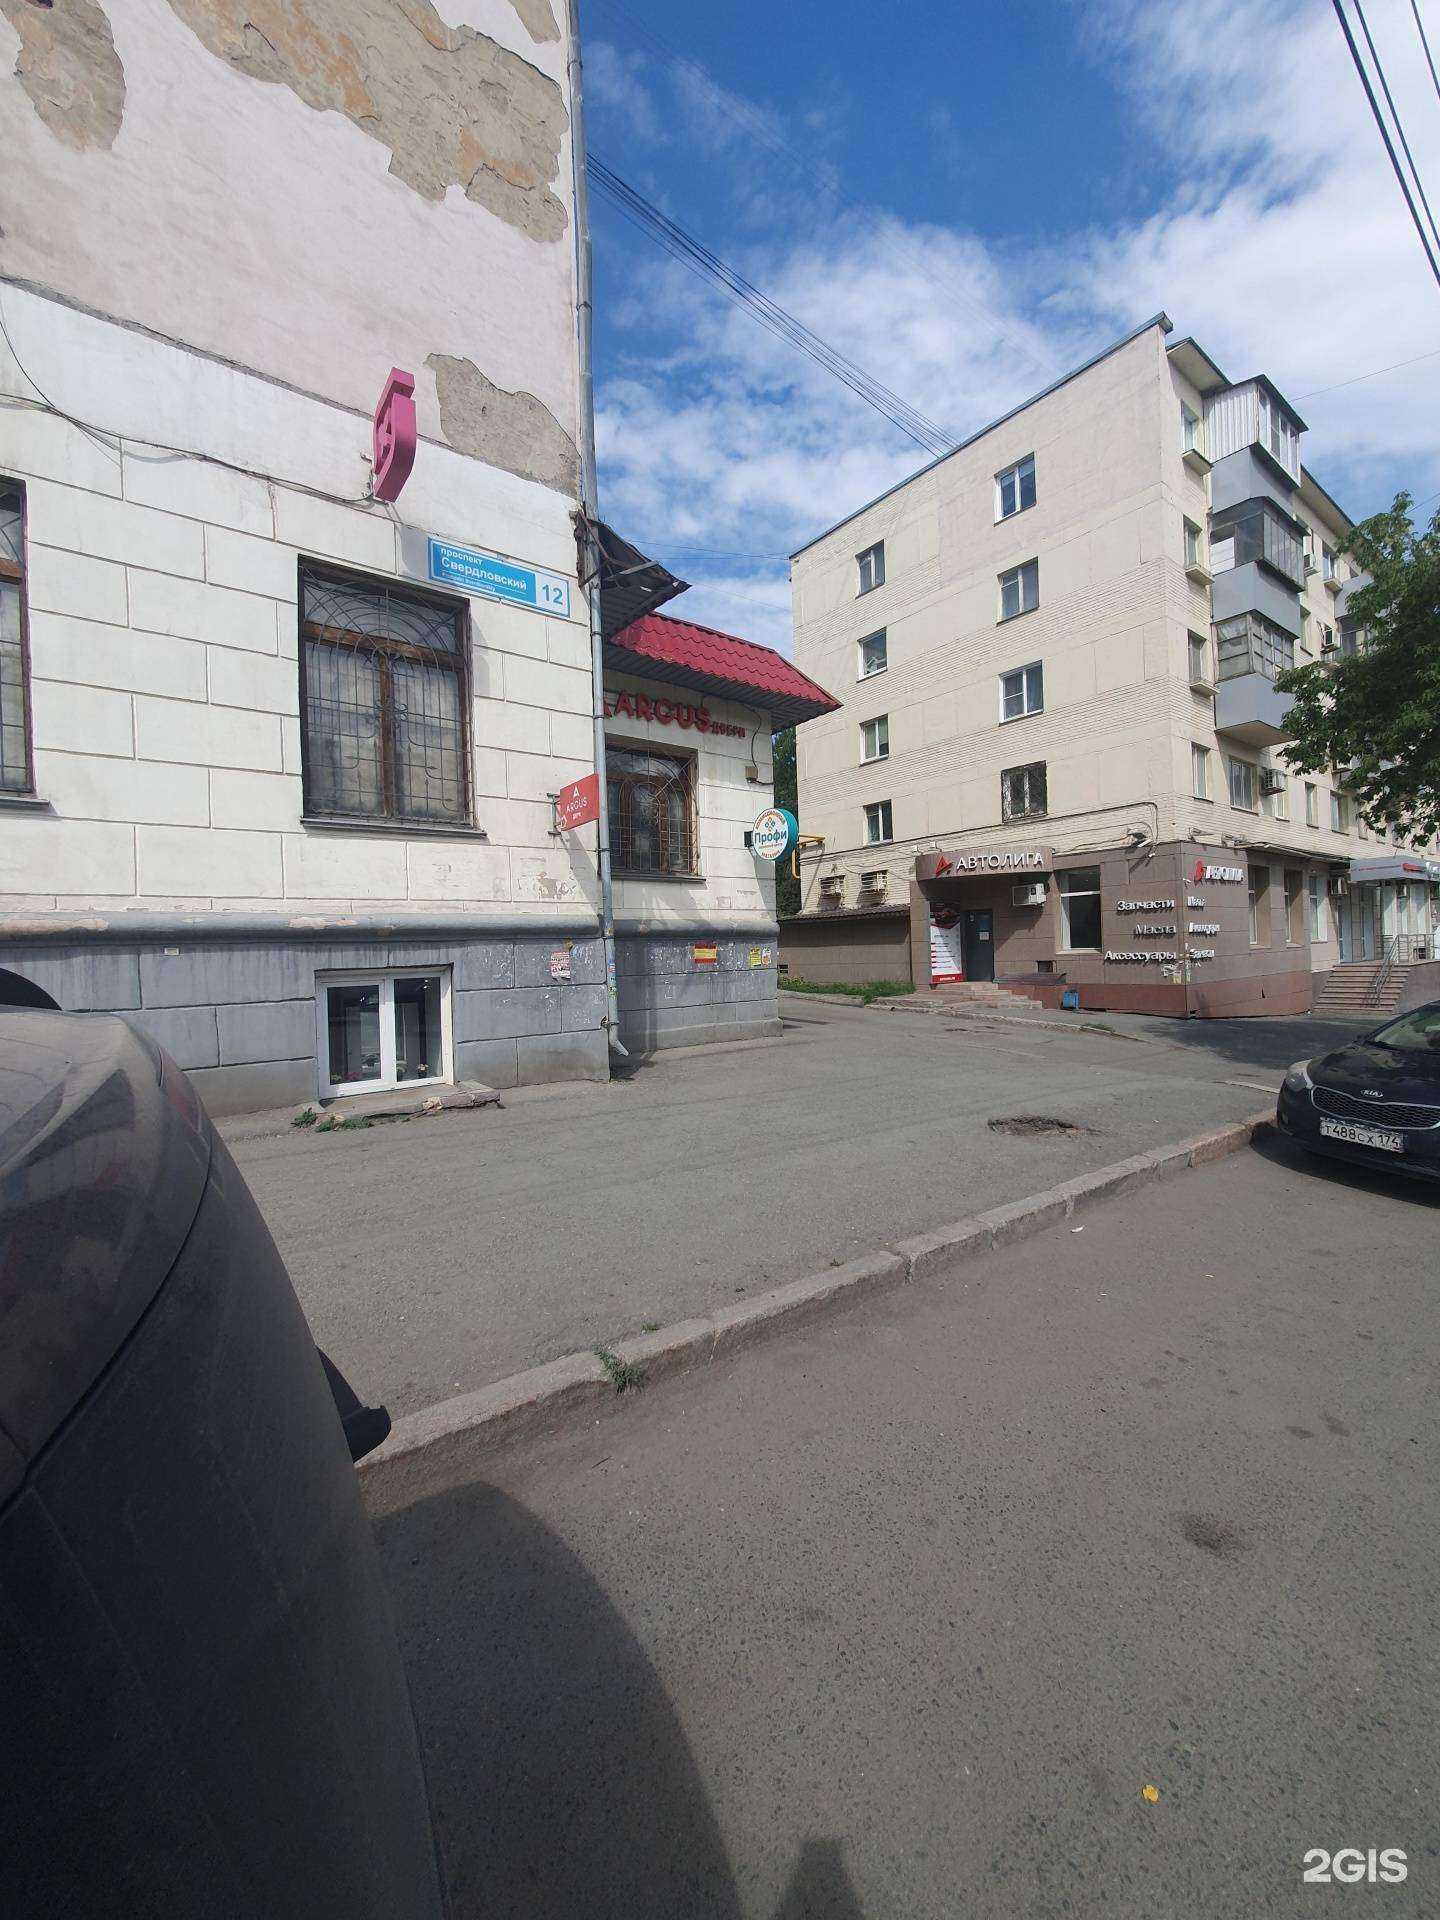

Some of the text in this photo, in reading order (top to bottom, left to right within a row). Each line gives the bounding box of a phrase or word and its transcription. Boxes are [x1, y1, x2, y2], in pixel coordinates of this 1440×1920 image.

[440, 547, 483, 566] проспект
[441, 557, 527, 590] Свердловский
[542, 584, 563, 605] 12
[754, 829, 788, 846] Профи
[956, 851, 1045, 871] АВТОЛИГА
[1117, 899, 1175, 911] Запчасти
[1135, 923, 1176, 935] Масла
[1104, 949, 1176, 962] Аксессуары
